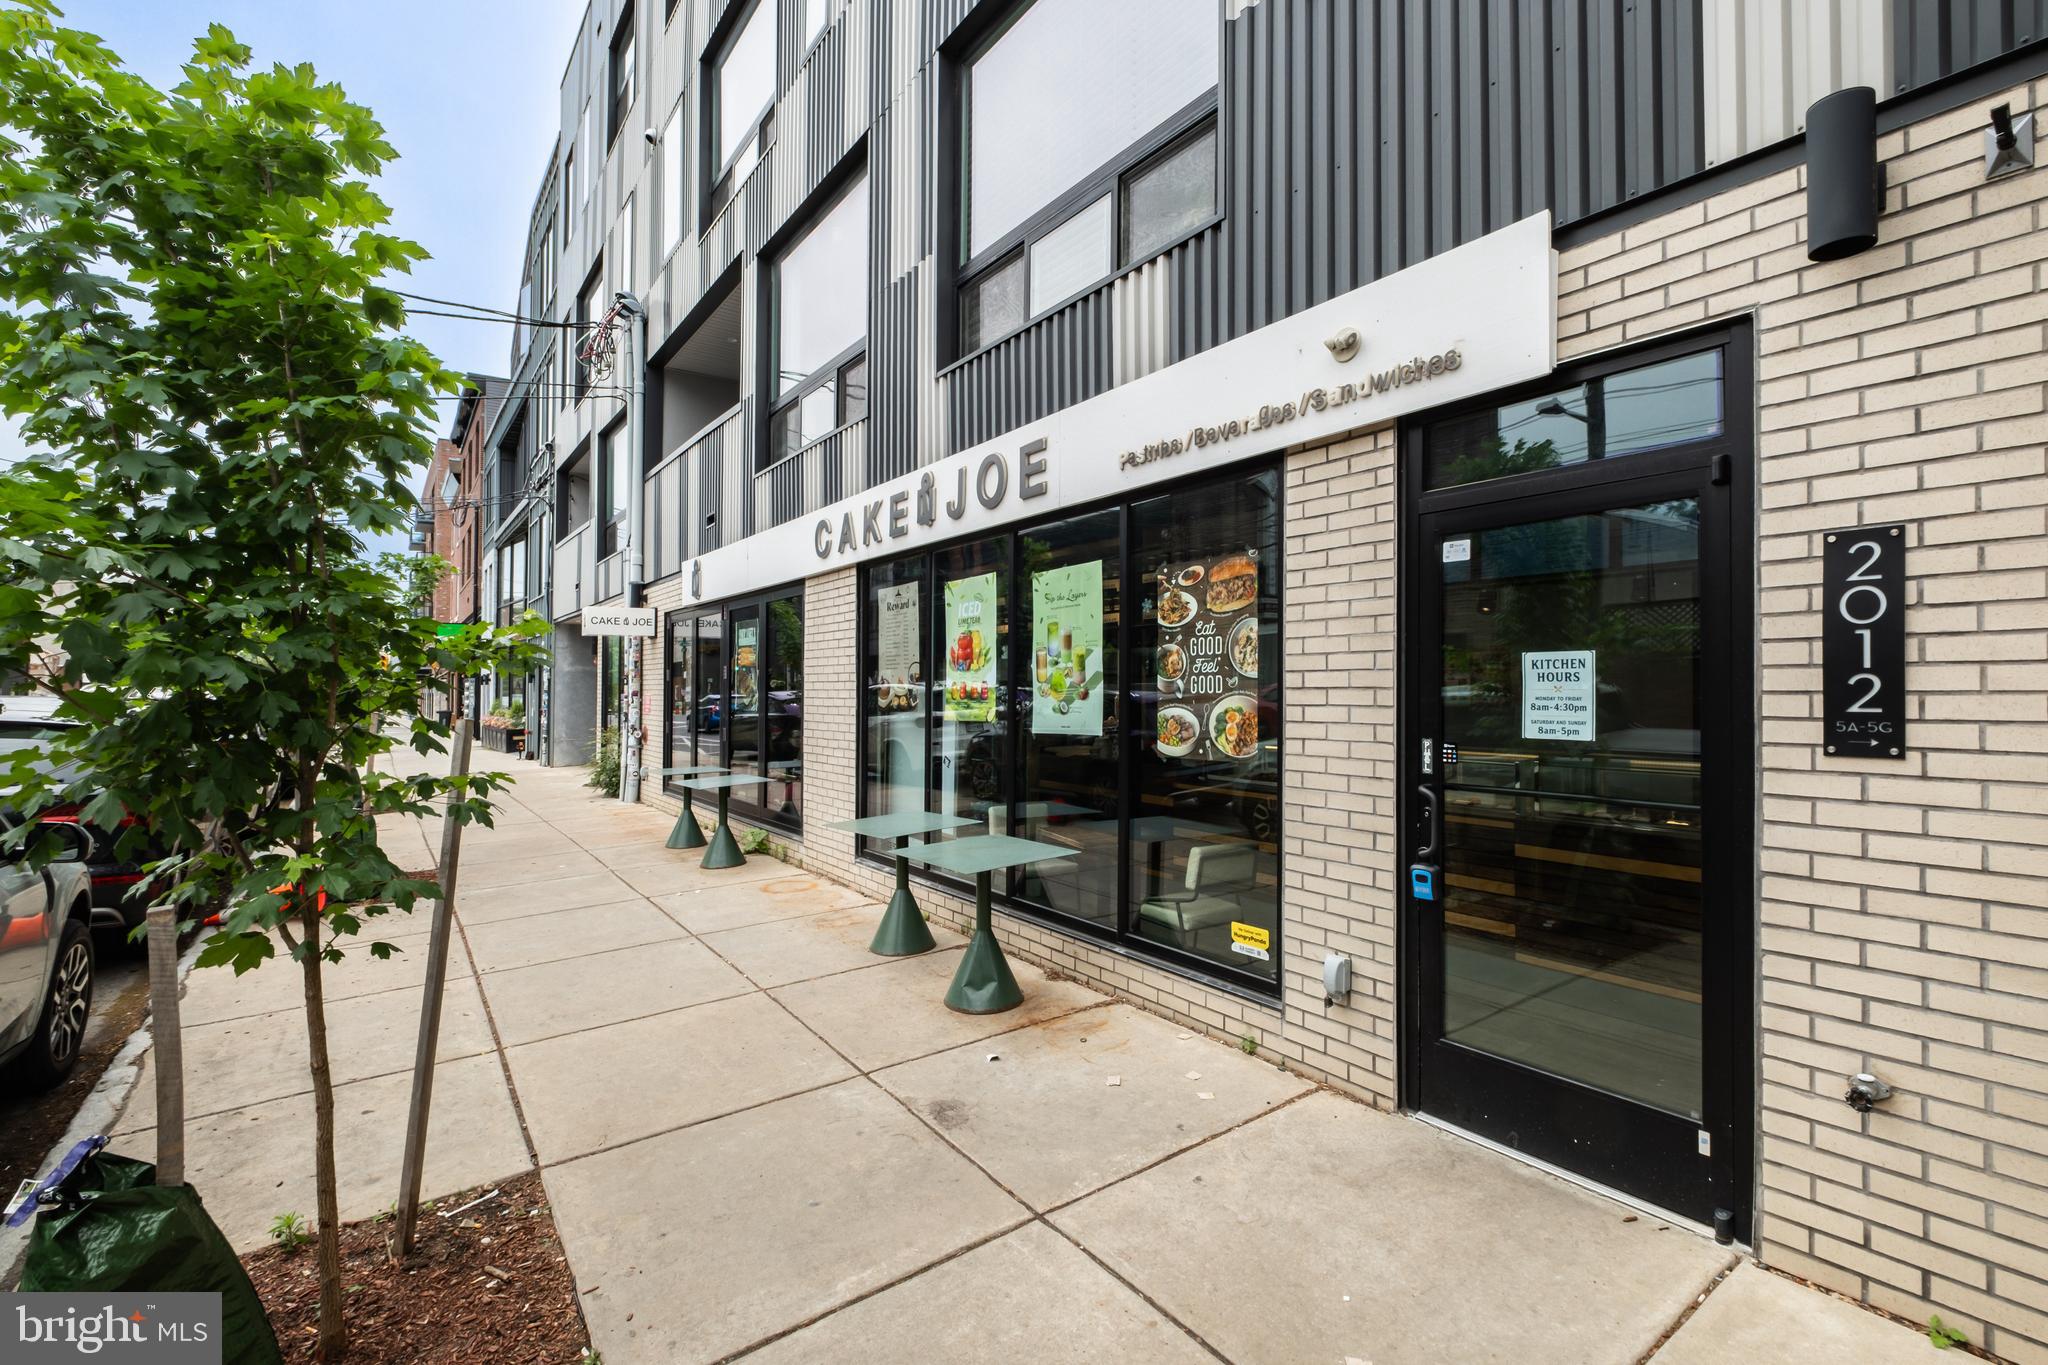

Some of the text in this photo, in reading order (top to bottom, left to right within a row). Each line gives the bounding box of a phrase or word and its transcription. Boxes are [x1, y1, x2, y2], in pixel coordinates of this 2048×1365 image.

[814, 490, 909, 559] CAKE
[946, 437, 1049, 520] JOE
[886, 599, 910, 612] Reward
[958, 601, 982, 617] ICED
[590, 616, 621, 625] CAKE
[632, 618, 653, 626] JOE
[1195, 620, 1216, 635] Eat
[1839, 541, 1887, 713] 2012
[1190, 636, 1223, 656] GOOD
[1192, 658, 1219, 673] Feel
[1531, 658, 1586, 670] KITCHEN
[1537, 672, 1580, 682] HOURS
[1190, 675, 1223, 694] GOOD
[1530, 703, 1587, 713] 8am-4:30pm
[1537, 727, 1580, 736] 8am-5pm
[1835, 721, 1893, 733] 5A-5G
